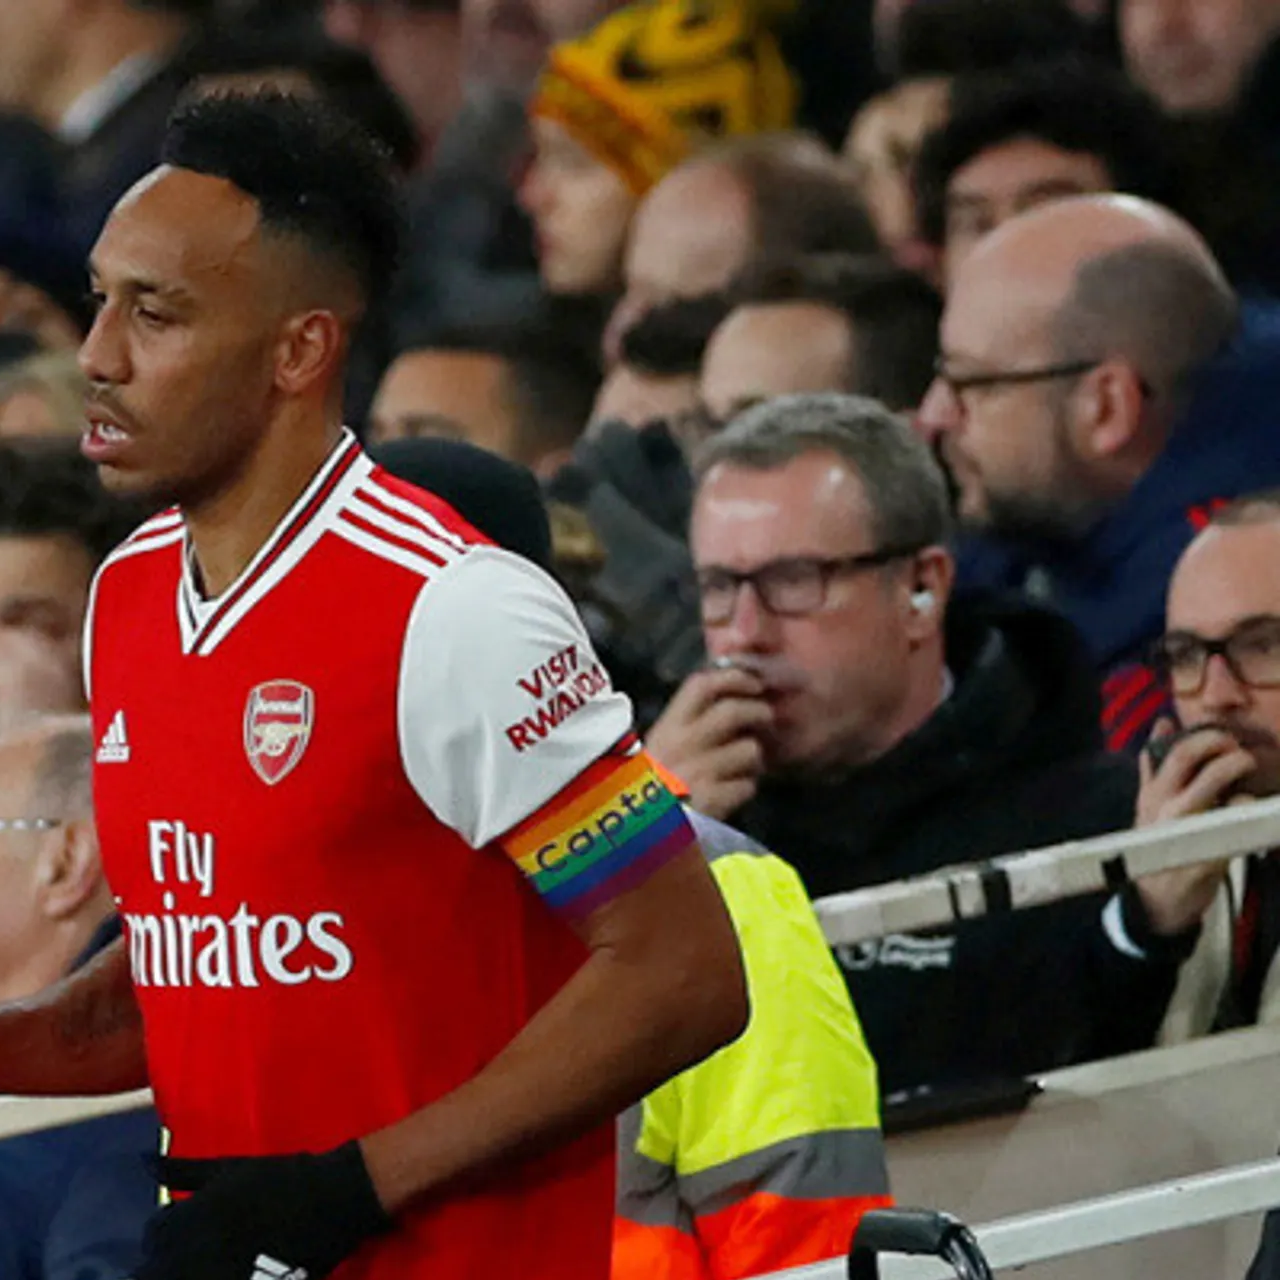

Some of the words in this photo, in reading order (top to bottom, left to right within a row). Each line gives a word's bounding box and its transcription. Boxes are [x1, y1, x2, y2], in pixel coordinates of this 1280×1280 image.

[516, 644, 578, 700] VISIT
[147, 819, 215, 897] Fly
[114, 889, 354, 989] mirates
